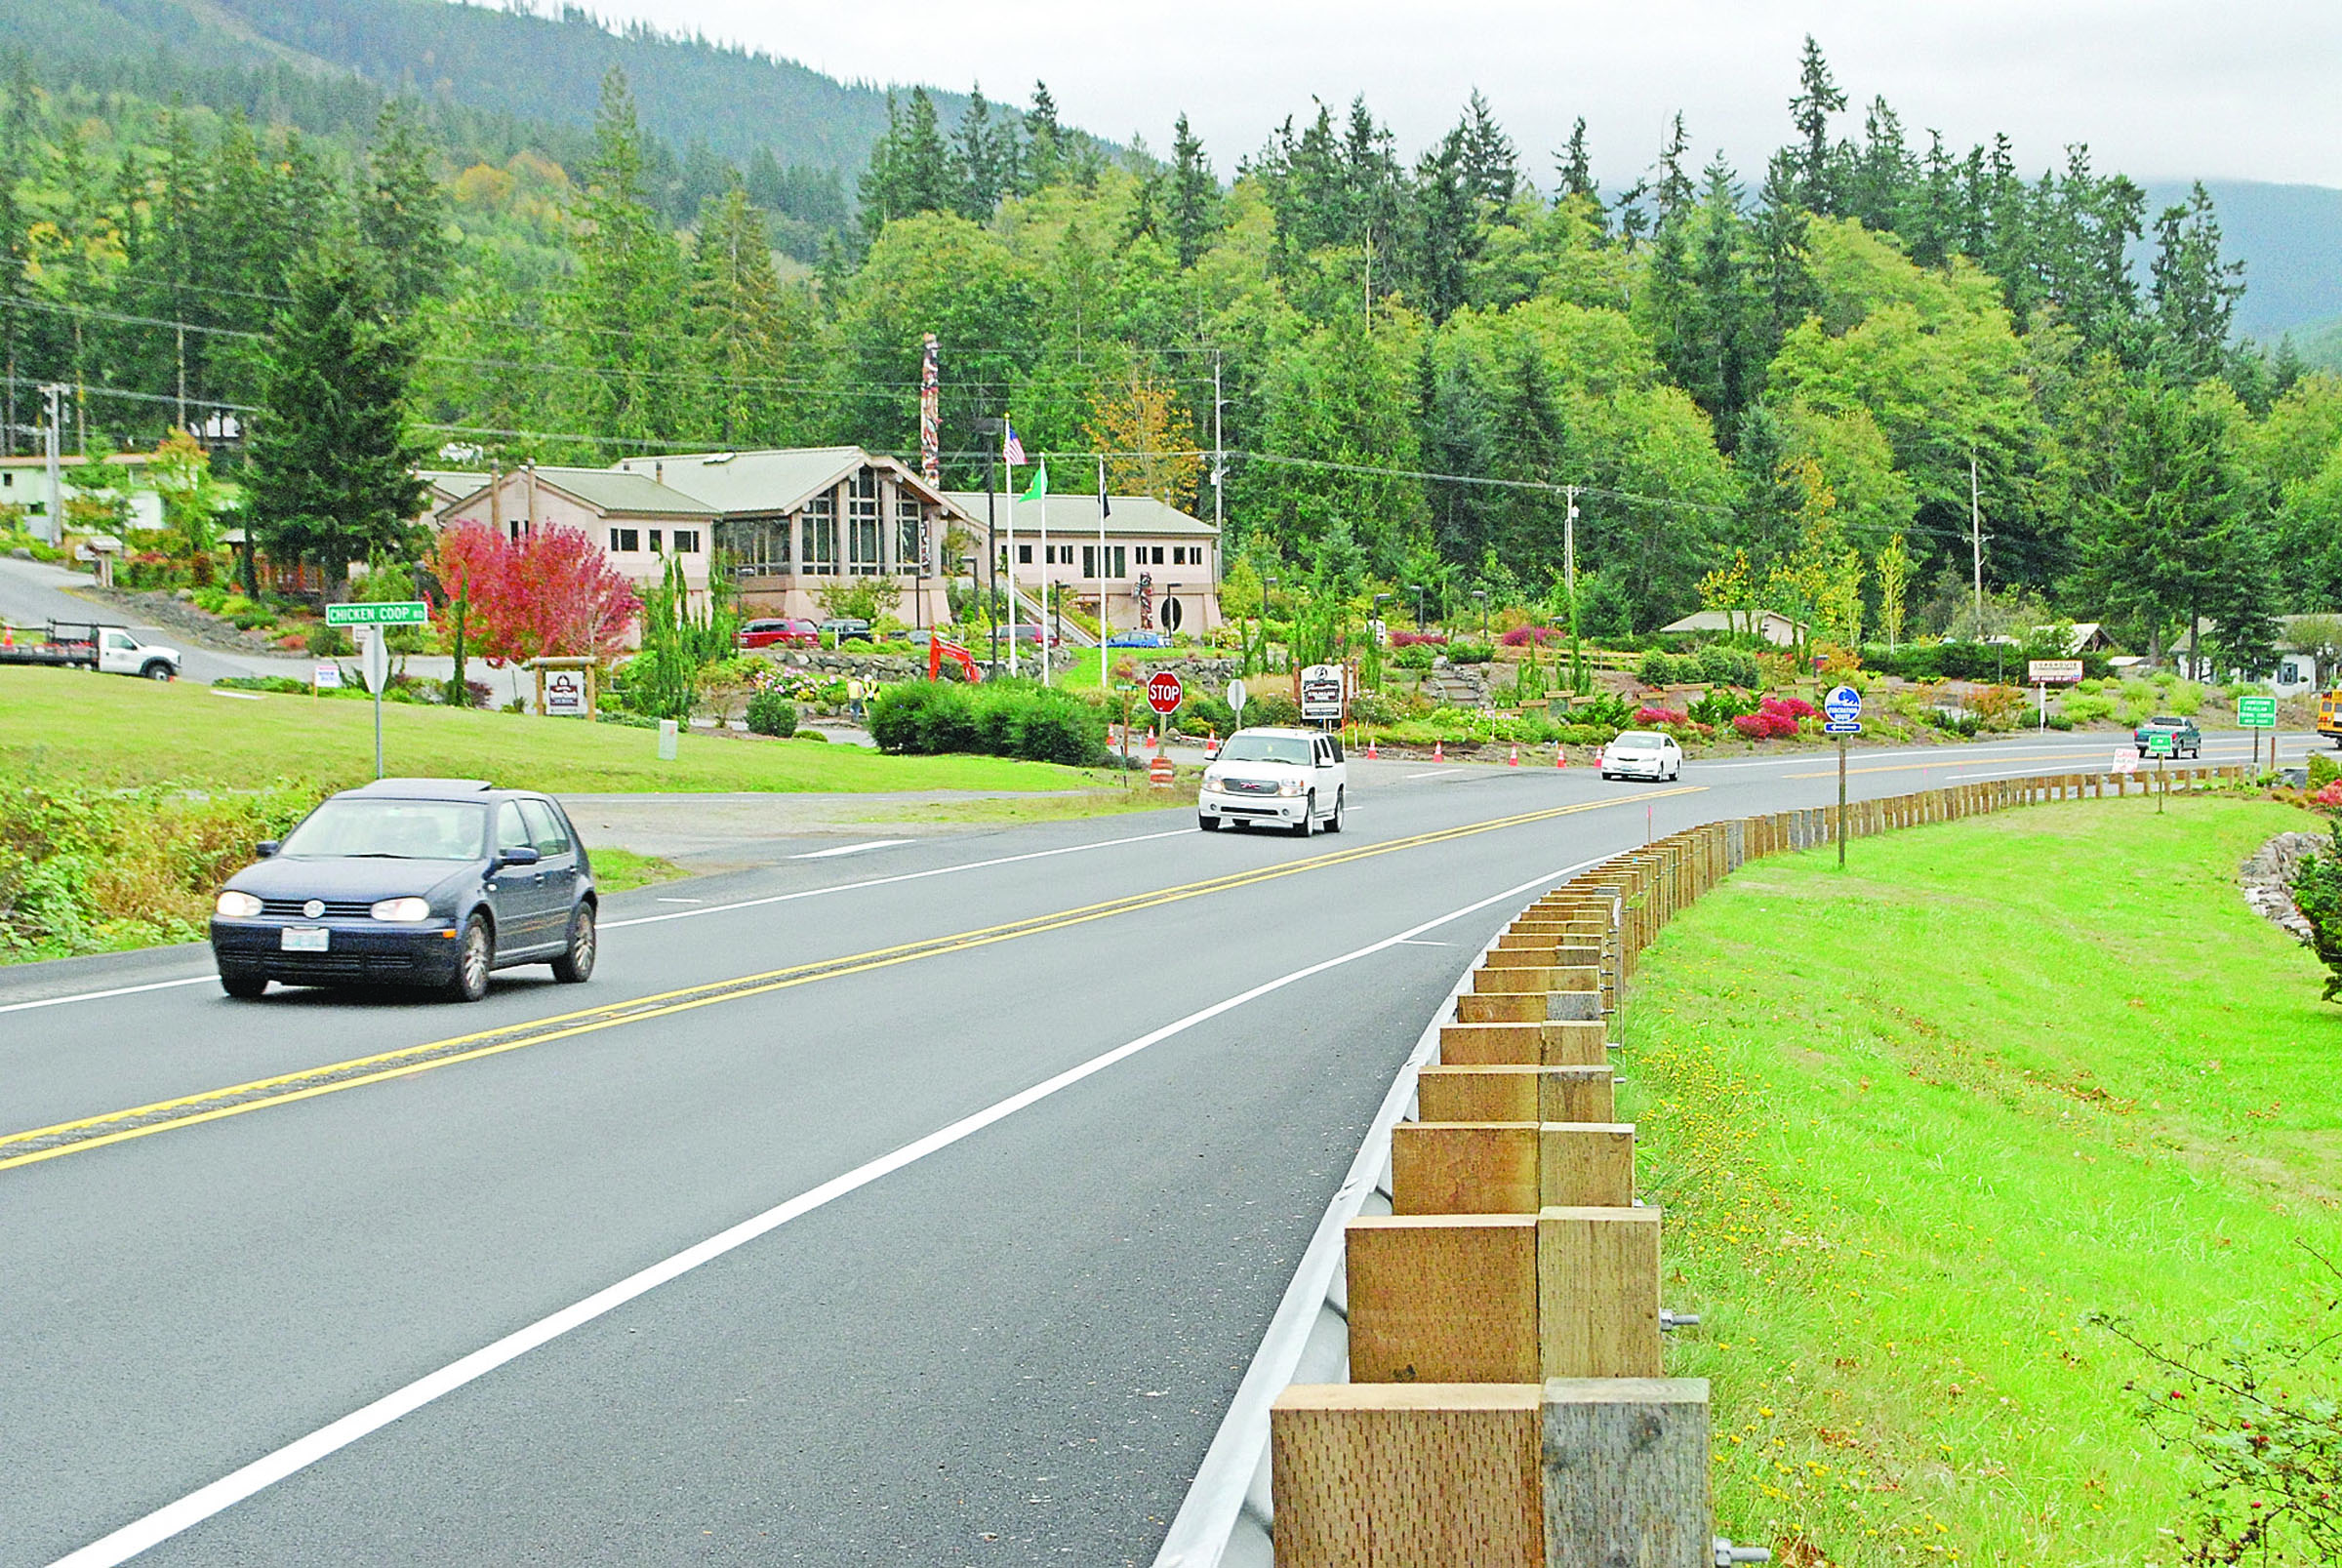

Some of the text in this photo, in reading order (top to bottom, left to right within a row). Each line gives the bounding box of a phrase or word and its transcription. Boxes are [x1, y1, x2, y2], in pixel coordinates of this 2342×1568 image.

[330, 608, 375, 622] CHICKEN
[380, 607, 409, 620] COOP
[1150, 684, 1180, 701] STOP
